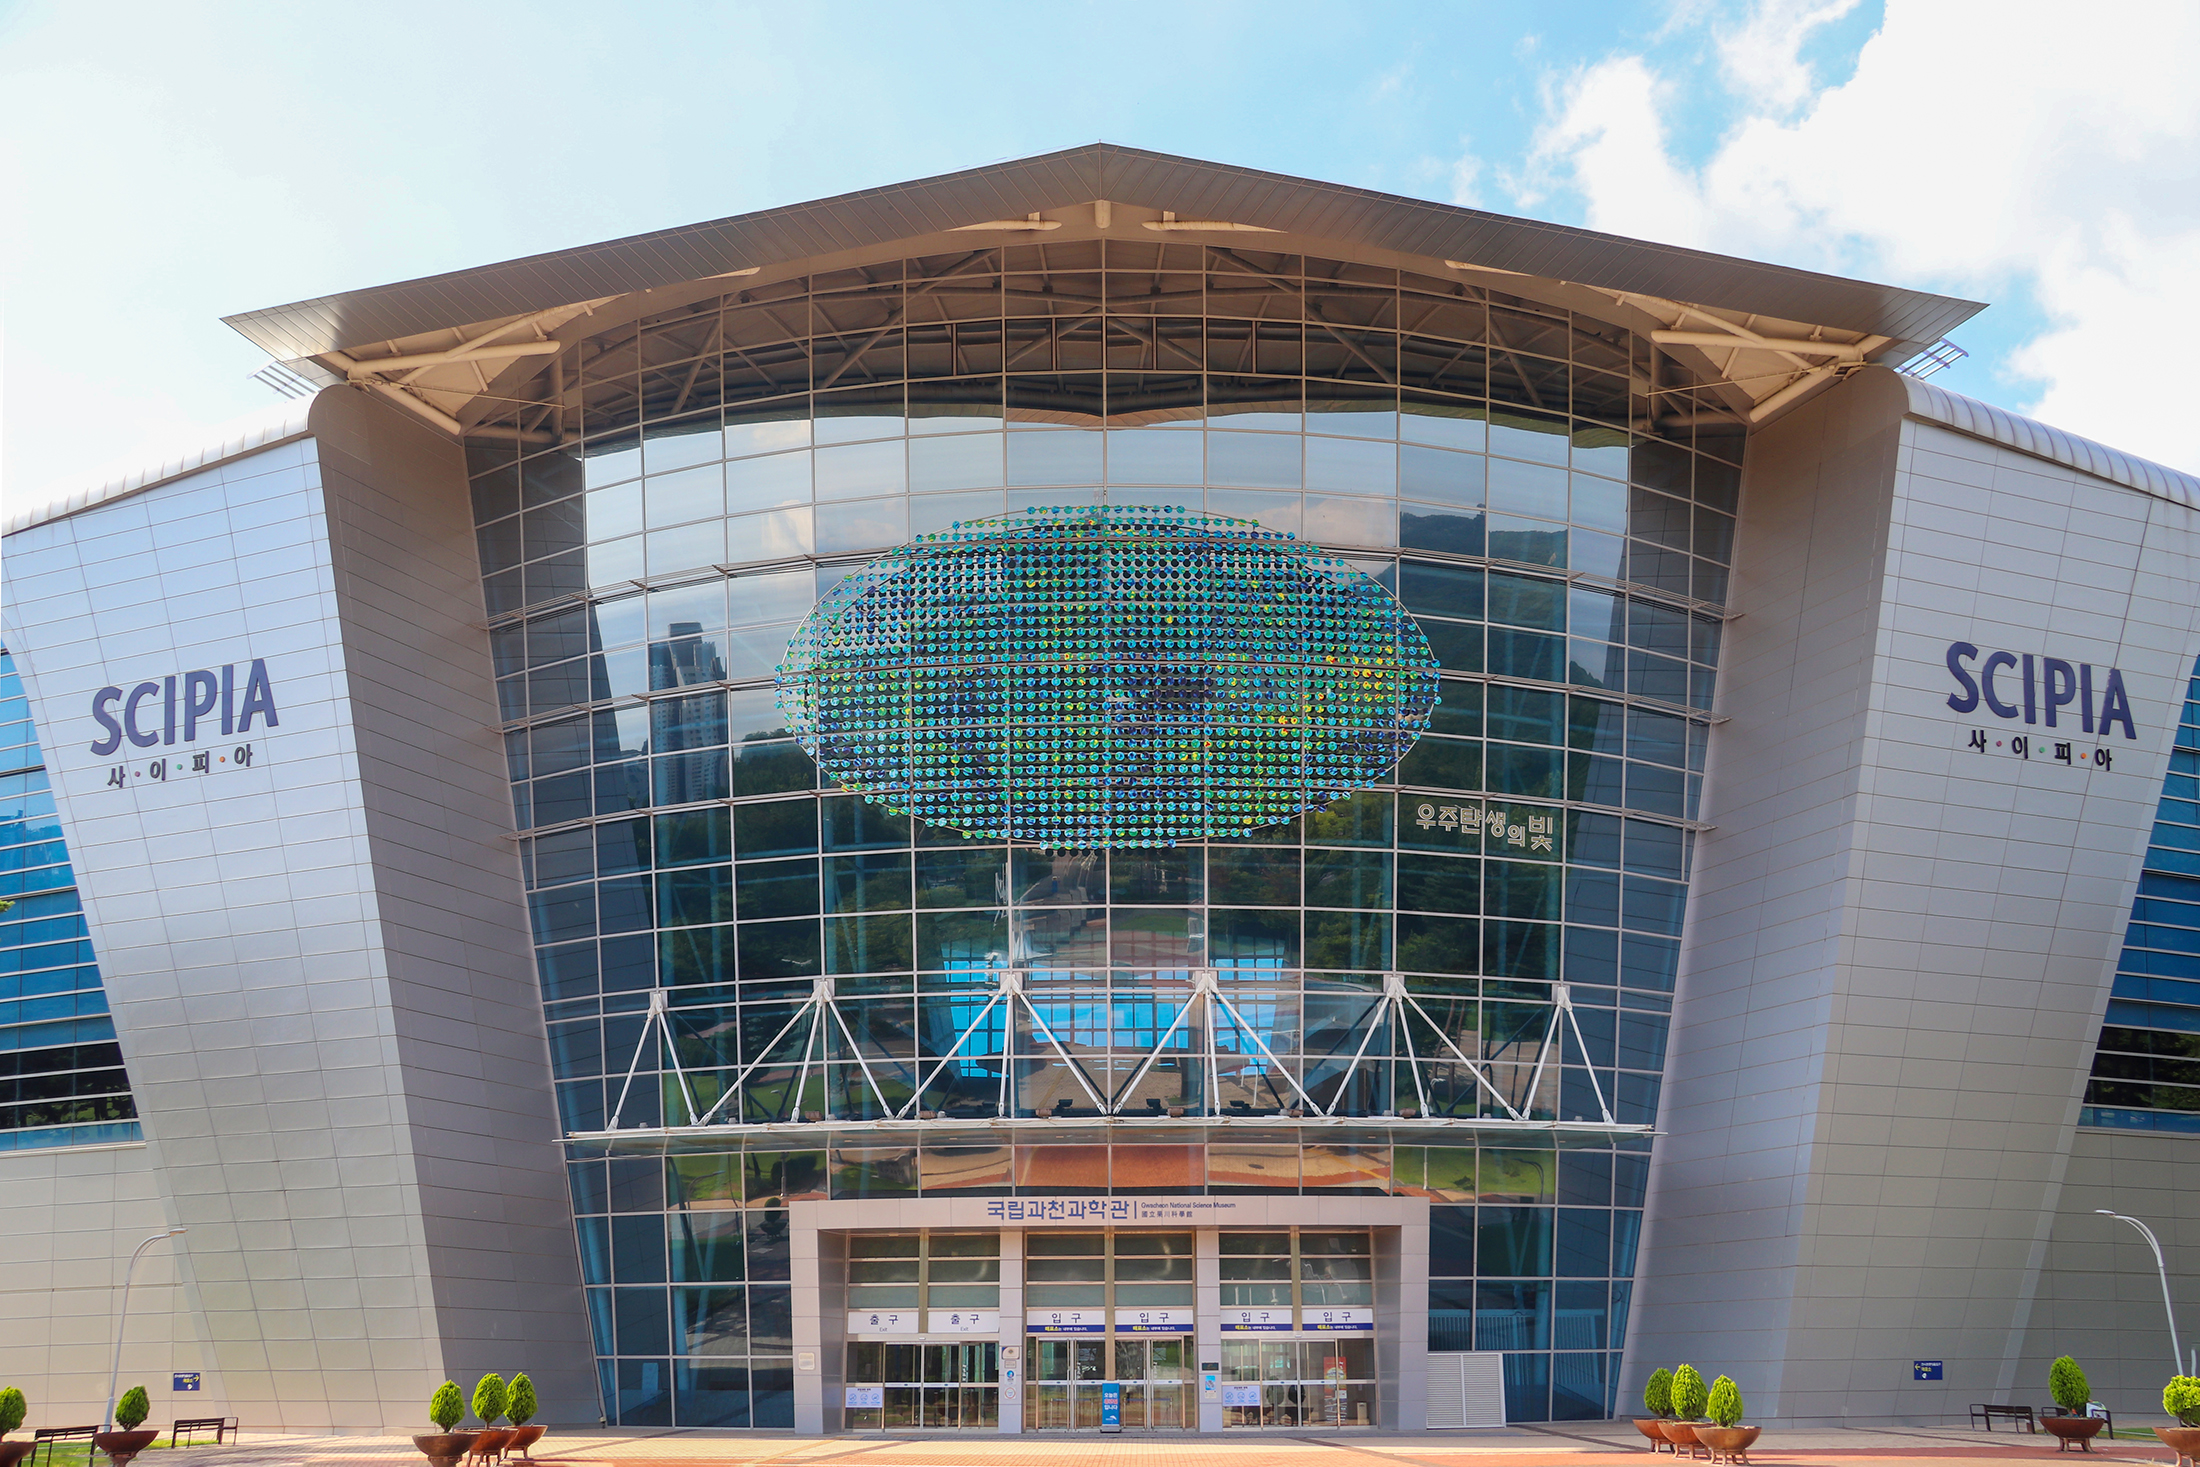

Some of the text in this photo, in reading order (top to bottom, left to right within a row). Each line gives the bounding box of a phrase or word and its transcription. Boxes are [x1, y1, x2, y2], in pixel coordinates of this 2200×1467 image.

[90, 658, 279, 756] SCIPIA
[1945, 641, 2137, 740] SCIPIA
[1528, 815, 1553, 852] 빛
[987, 1200, 1130, 1220] 국립과천과학관
